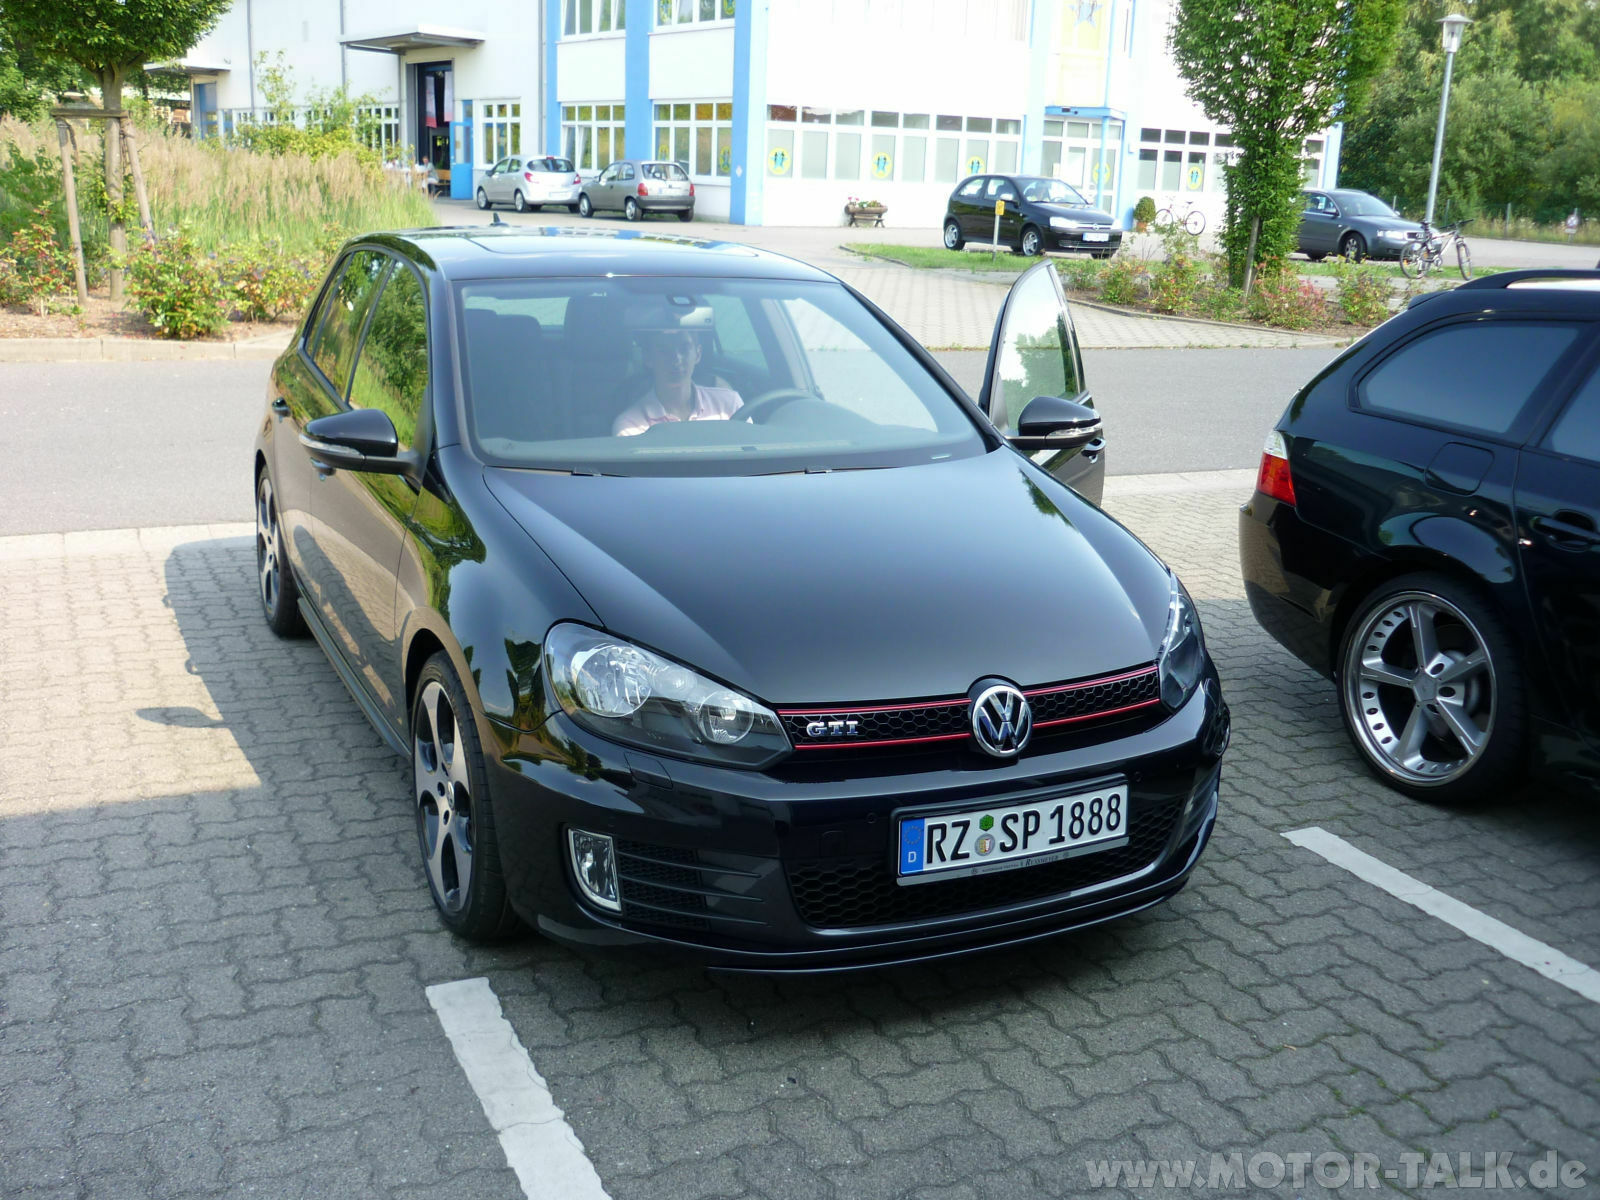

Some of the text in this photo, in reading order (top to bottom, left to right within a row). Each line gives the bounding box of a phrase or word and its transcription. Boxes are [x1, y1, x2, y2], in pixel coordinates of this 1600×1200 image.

[806, 720, 858, 738] GTI
[926, 820, 971, 864] RZ
[999, 810, 1041, 853] SP
[1048, 793, 1121, 845] 1888
[907, 851, 917, 863] D
